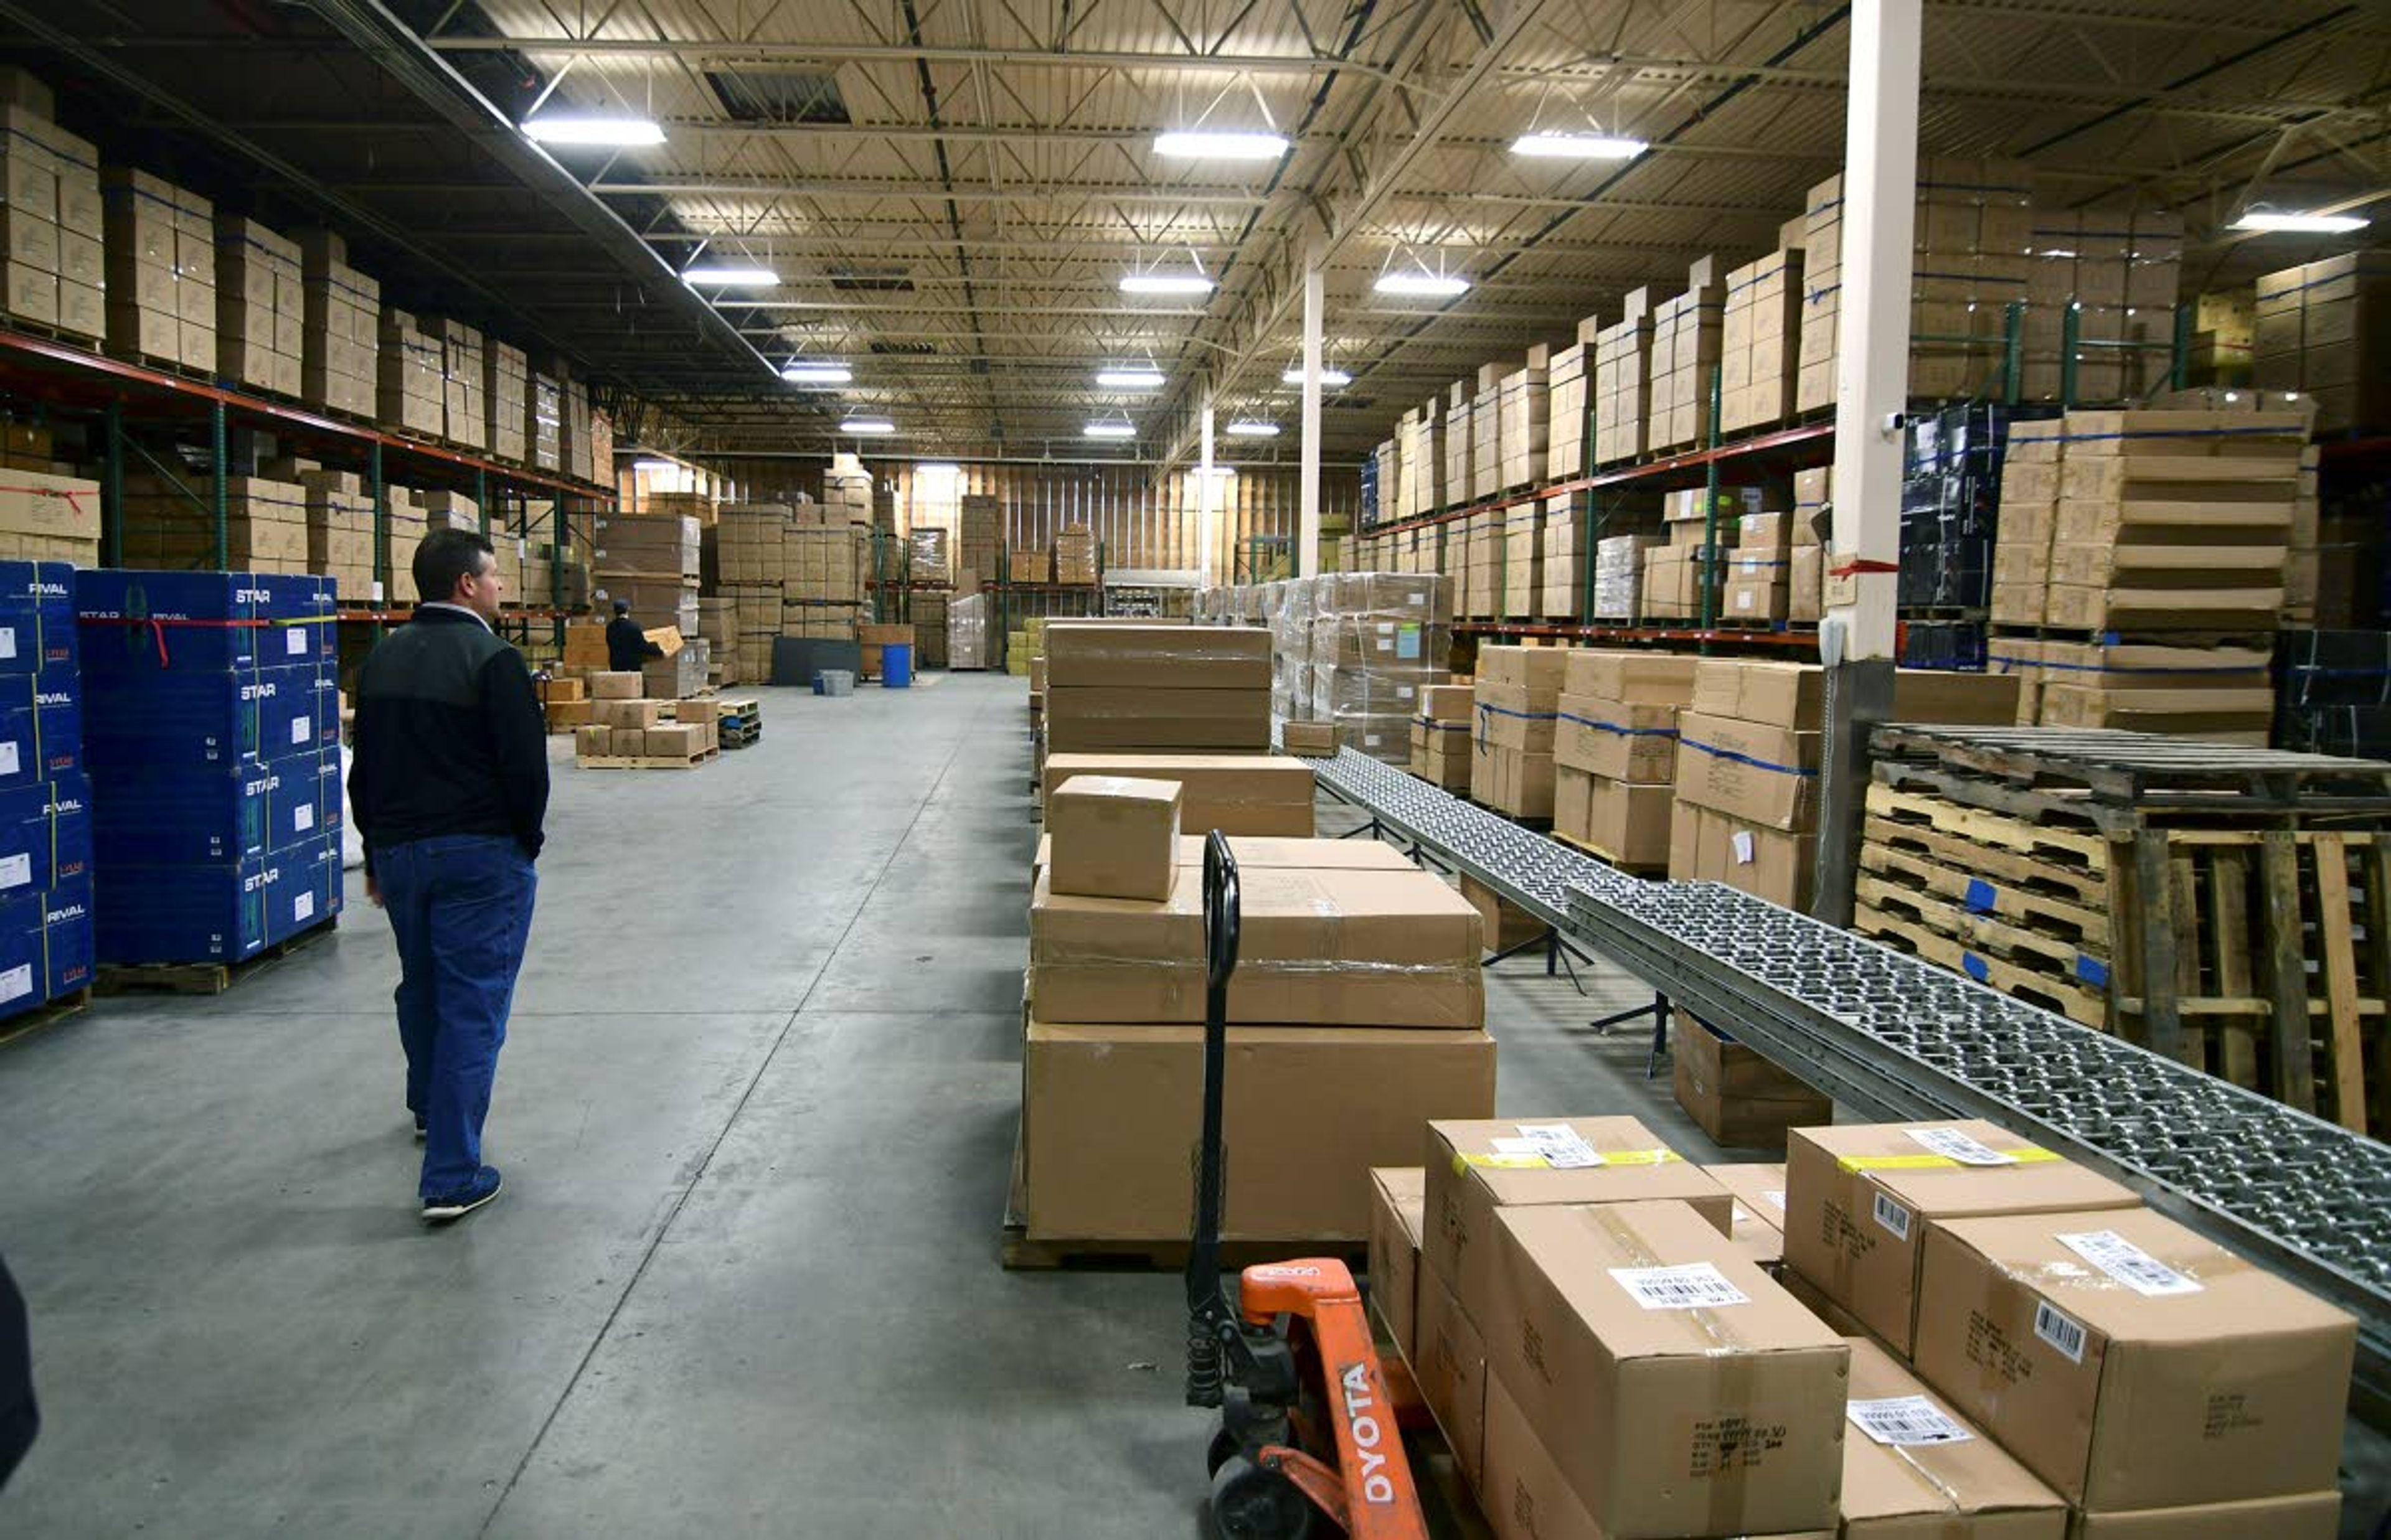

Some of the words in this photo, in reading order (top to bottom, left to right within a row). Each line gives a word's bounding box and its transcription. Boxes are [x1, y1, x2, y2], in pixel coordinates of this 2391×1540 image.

[28, 583, 68, 594] RVAL
[236, 589, 270, 603] STAR
[240, 683, 276, 700] STAR
[246, 776, 279, 796] STAR
[42, 799, 83, 815] RVAL
[245, 868, 279, 892] STAR
[47, 904, 86, 923] RIVAL
